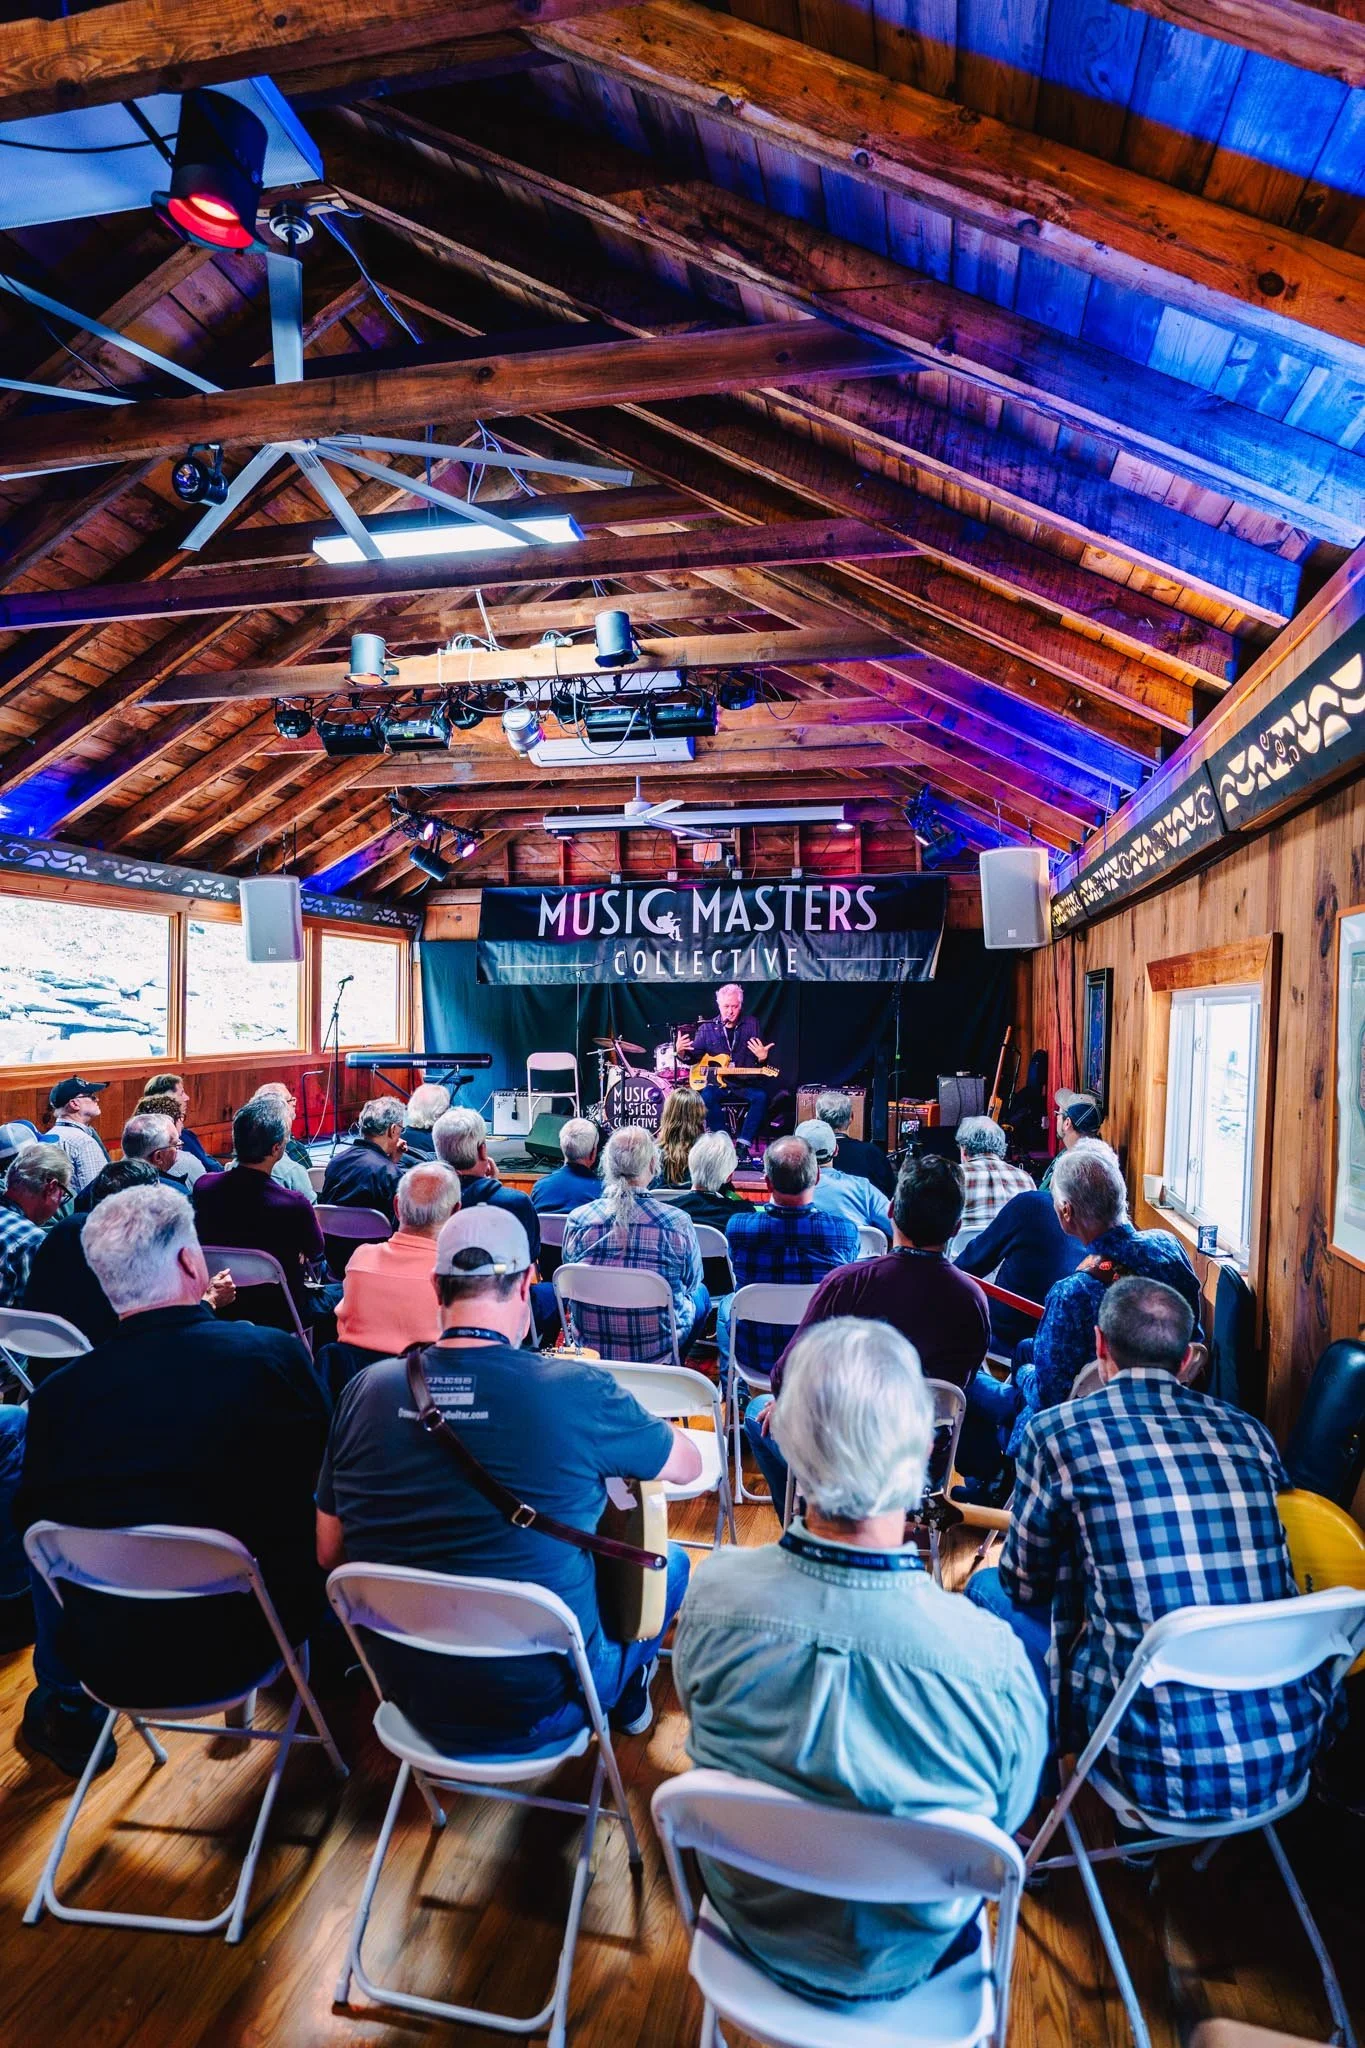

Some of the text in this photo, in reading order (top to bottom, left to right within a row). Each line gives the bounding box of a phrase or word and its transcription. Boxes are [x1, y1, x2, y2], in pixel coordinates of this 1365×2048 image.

[537, 885, 877, 937] MUSIC MASTERS
[615, 948, 798, 976] COLLECTIVE
[613, 1086, 654, 1102] MUSIC
